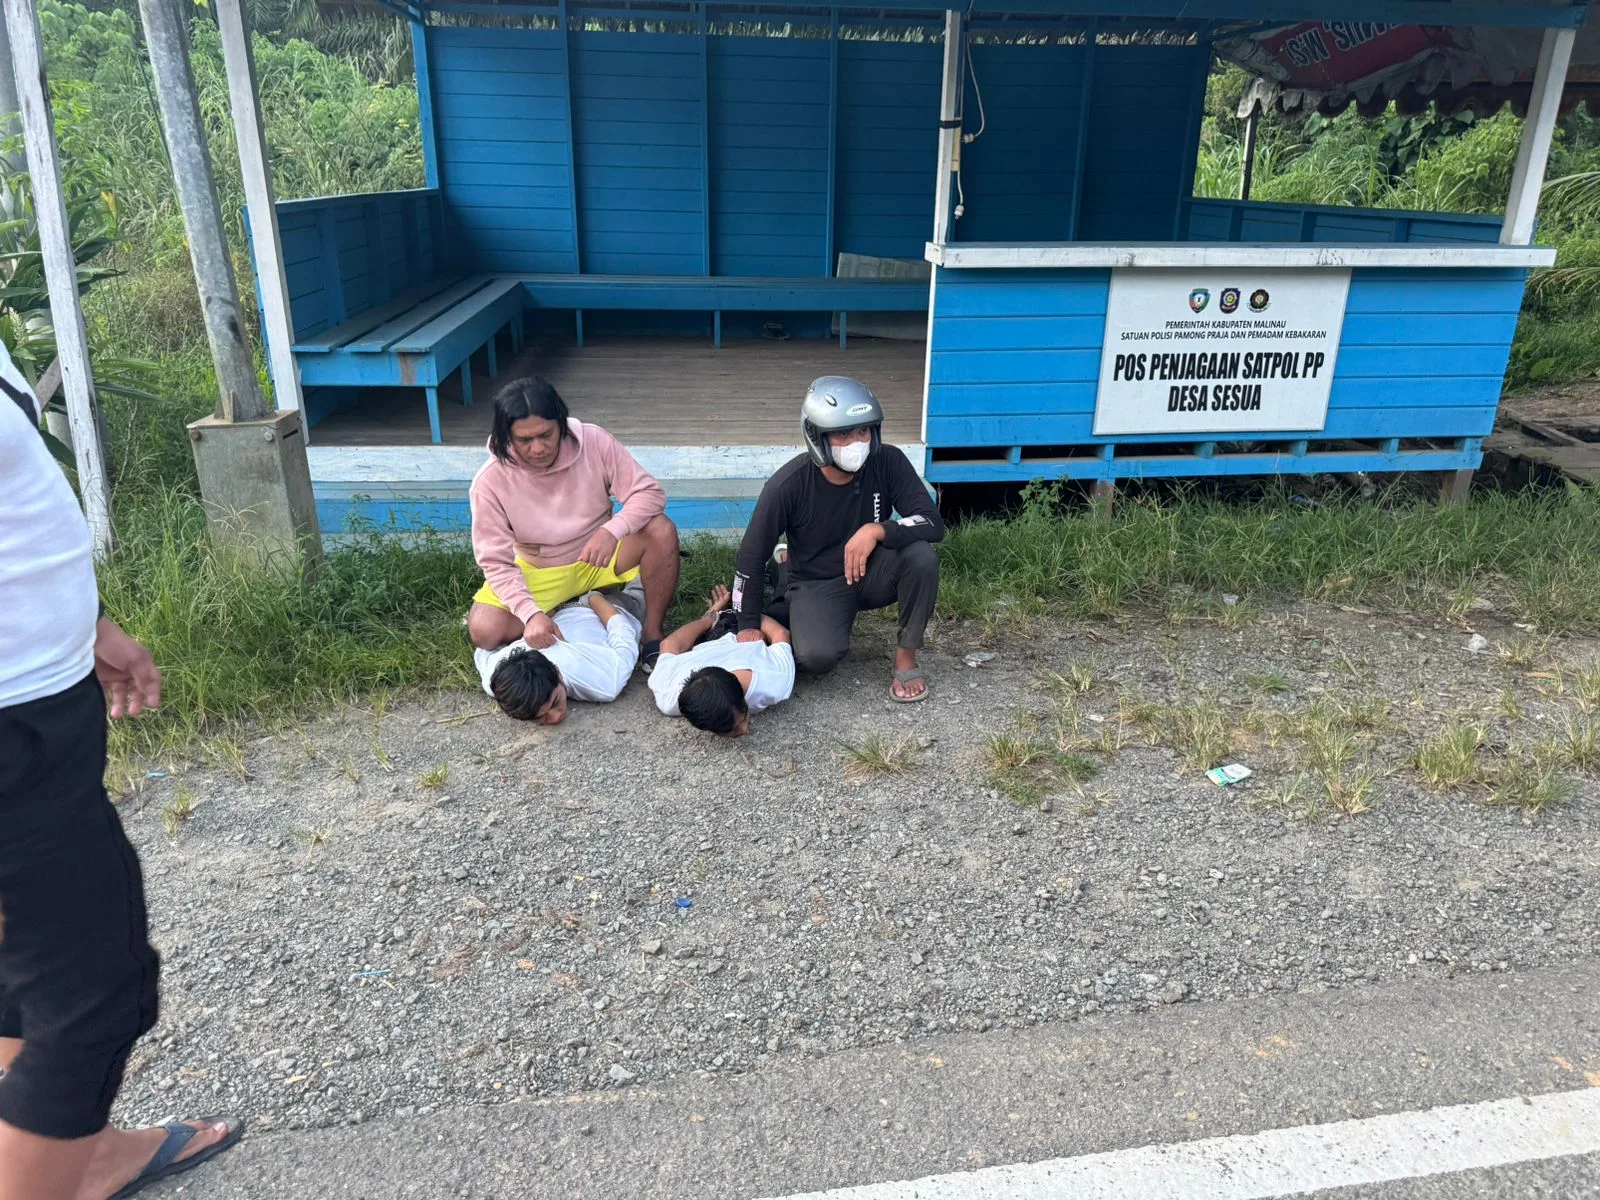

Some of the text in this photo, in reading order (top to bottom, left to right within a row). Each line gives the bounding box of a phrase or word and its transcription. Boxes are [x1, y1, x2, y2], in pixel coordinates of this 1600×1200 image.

[1165, 320, 1287, 329] PEMERINTAH KABUPATEN MALINAU
[1120, 330, 1327, 341] SATUAN POLISI PAMONG PRAJA DAN PEMADAM KEBAKARAN
[1113, 351, 1325, 381] POS PENJAGAAN SATPOL PP
[1167, 384, 1262, 412] DESA SESUA
